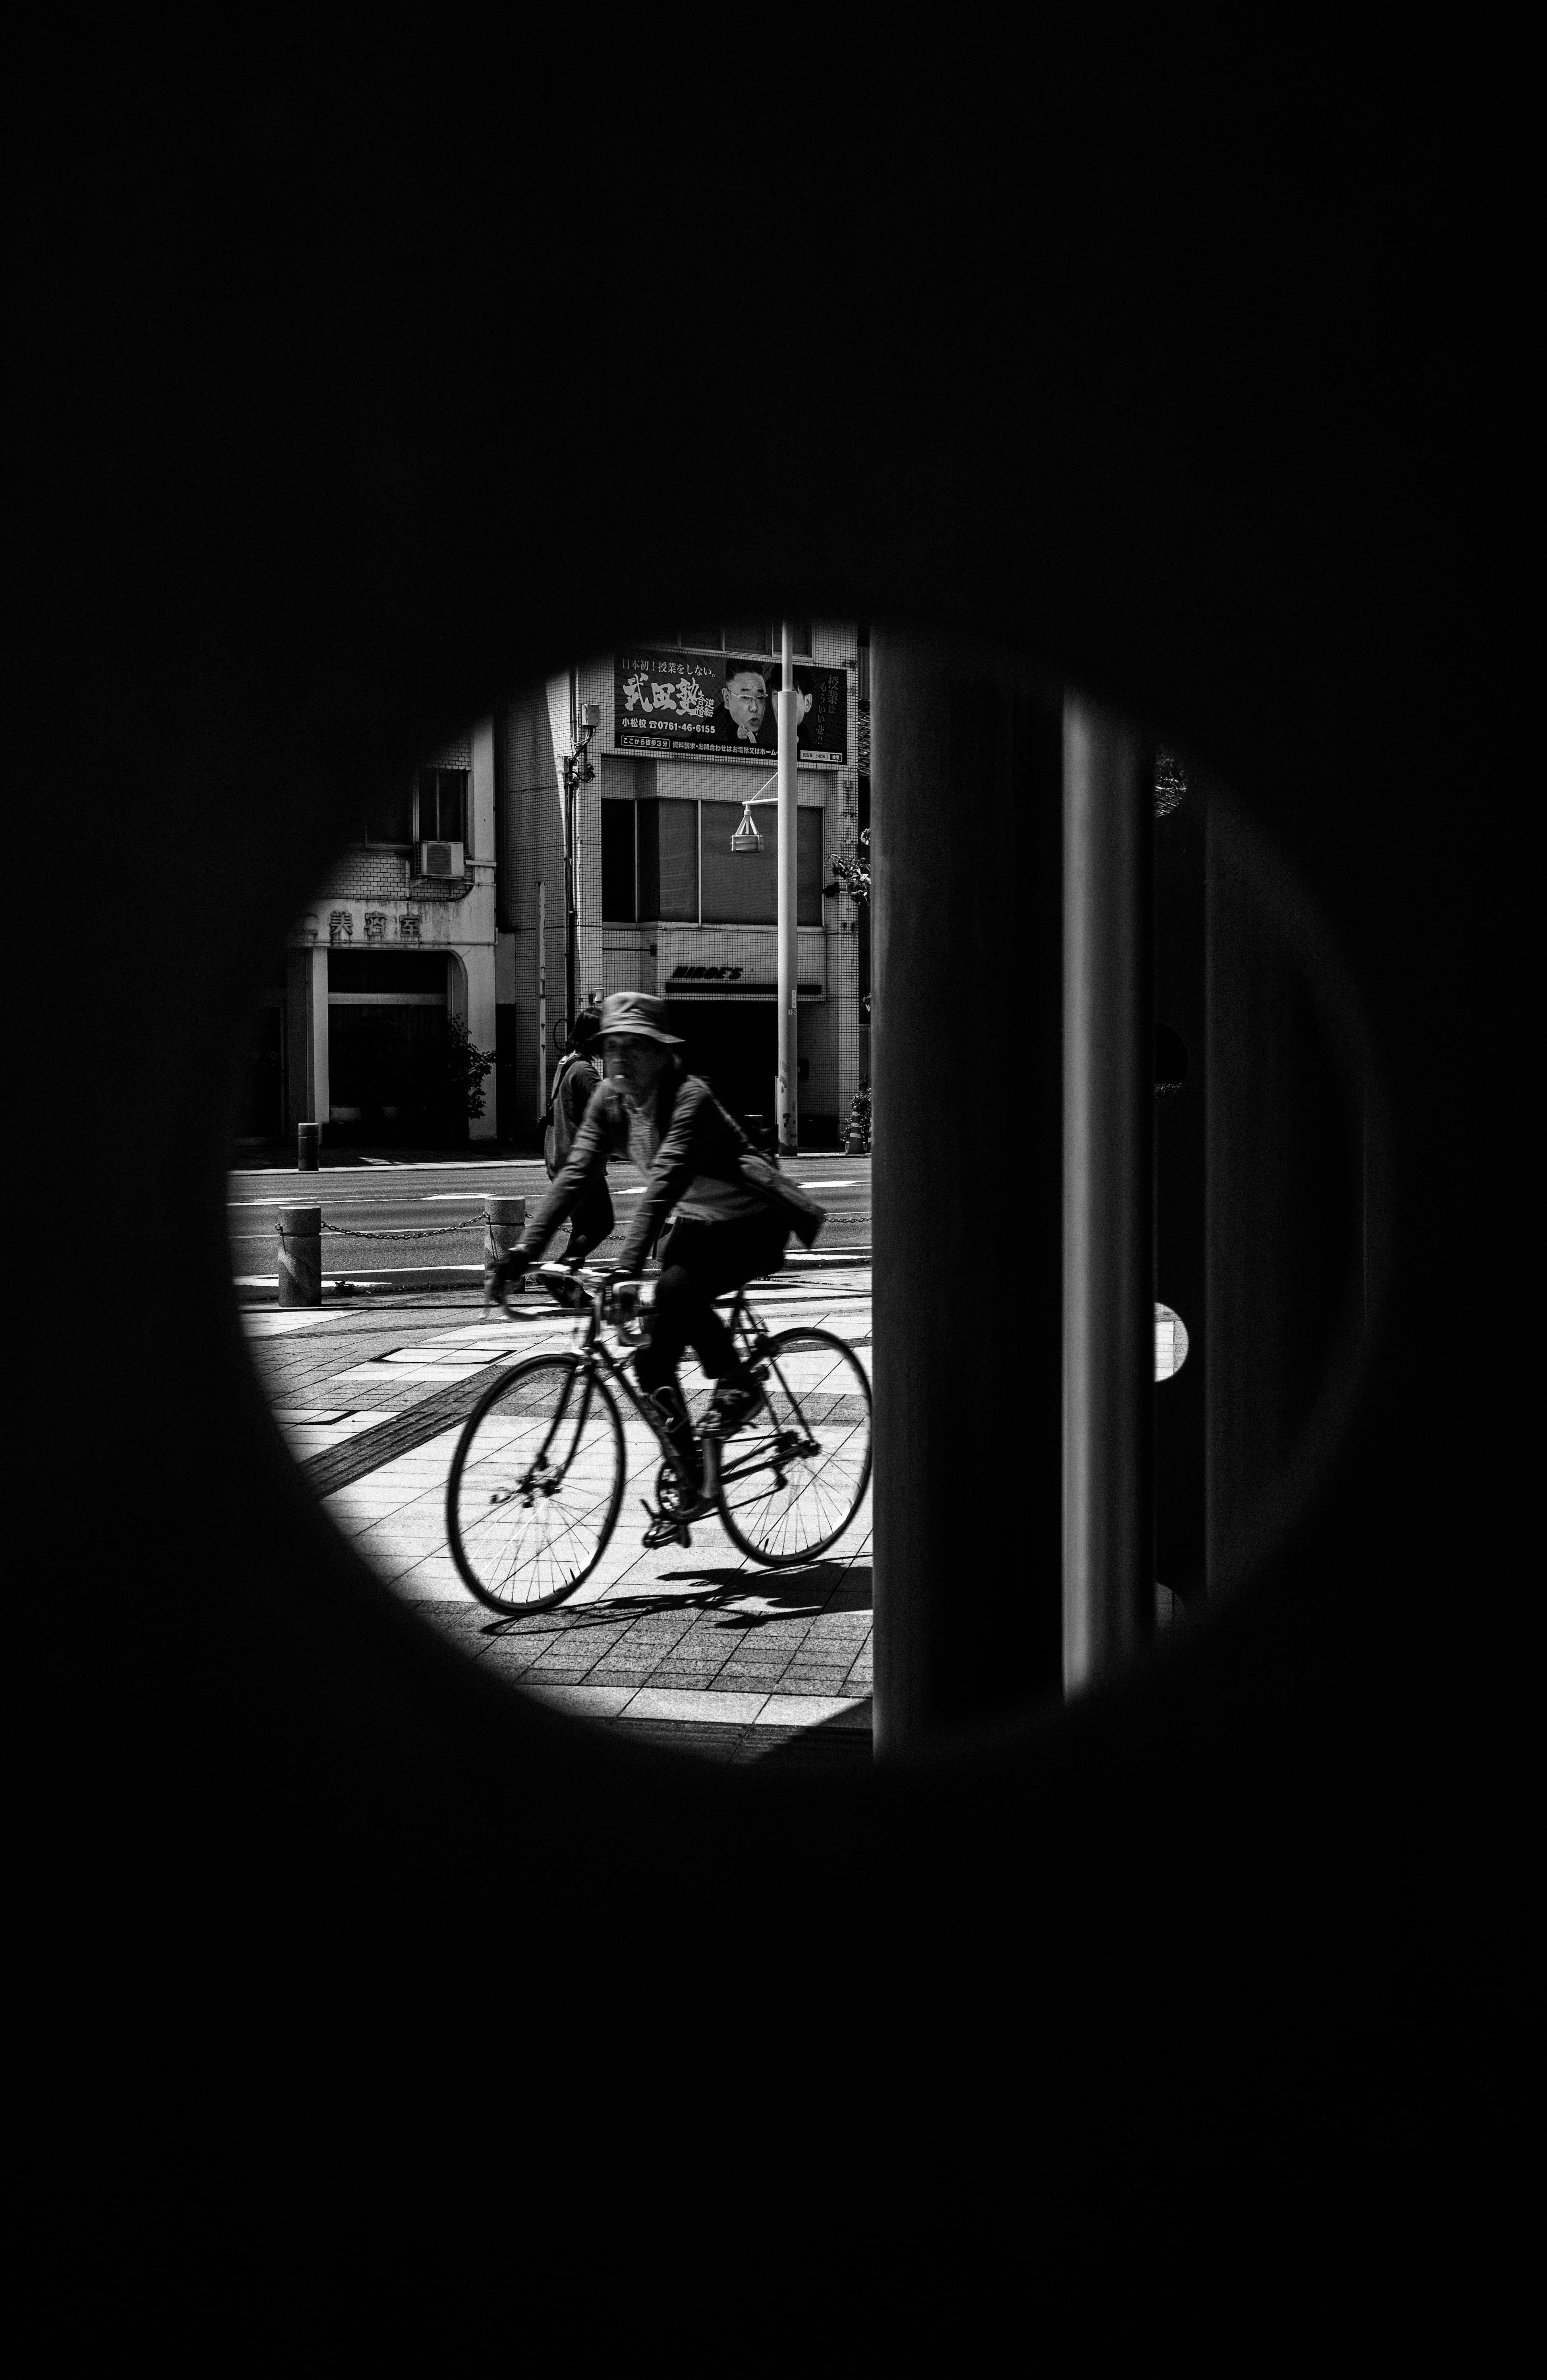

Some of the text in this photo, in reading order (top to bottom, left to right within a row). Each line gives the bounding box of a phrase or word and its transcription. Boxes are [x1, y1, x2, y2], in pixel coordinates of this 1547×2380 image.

[622, 673, 705, 718] 武田塾
[827, 674, 839, 714] 授業は
[622, 717, 715, 733] 小松校 0761-46-6155
[623, 737, 668, 747] ここから徒歩3分
[672, 741, 778, 756] 資料請求・お問合わせはお電話又はホーム
[672, 967, 744, 979] HIROE'S
